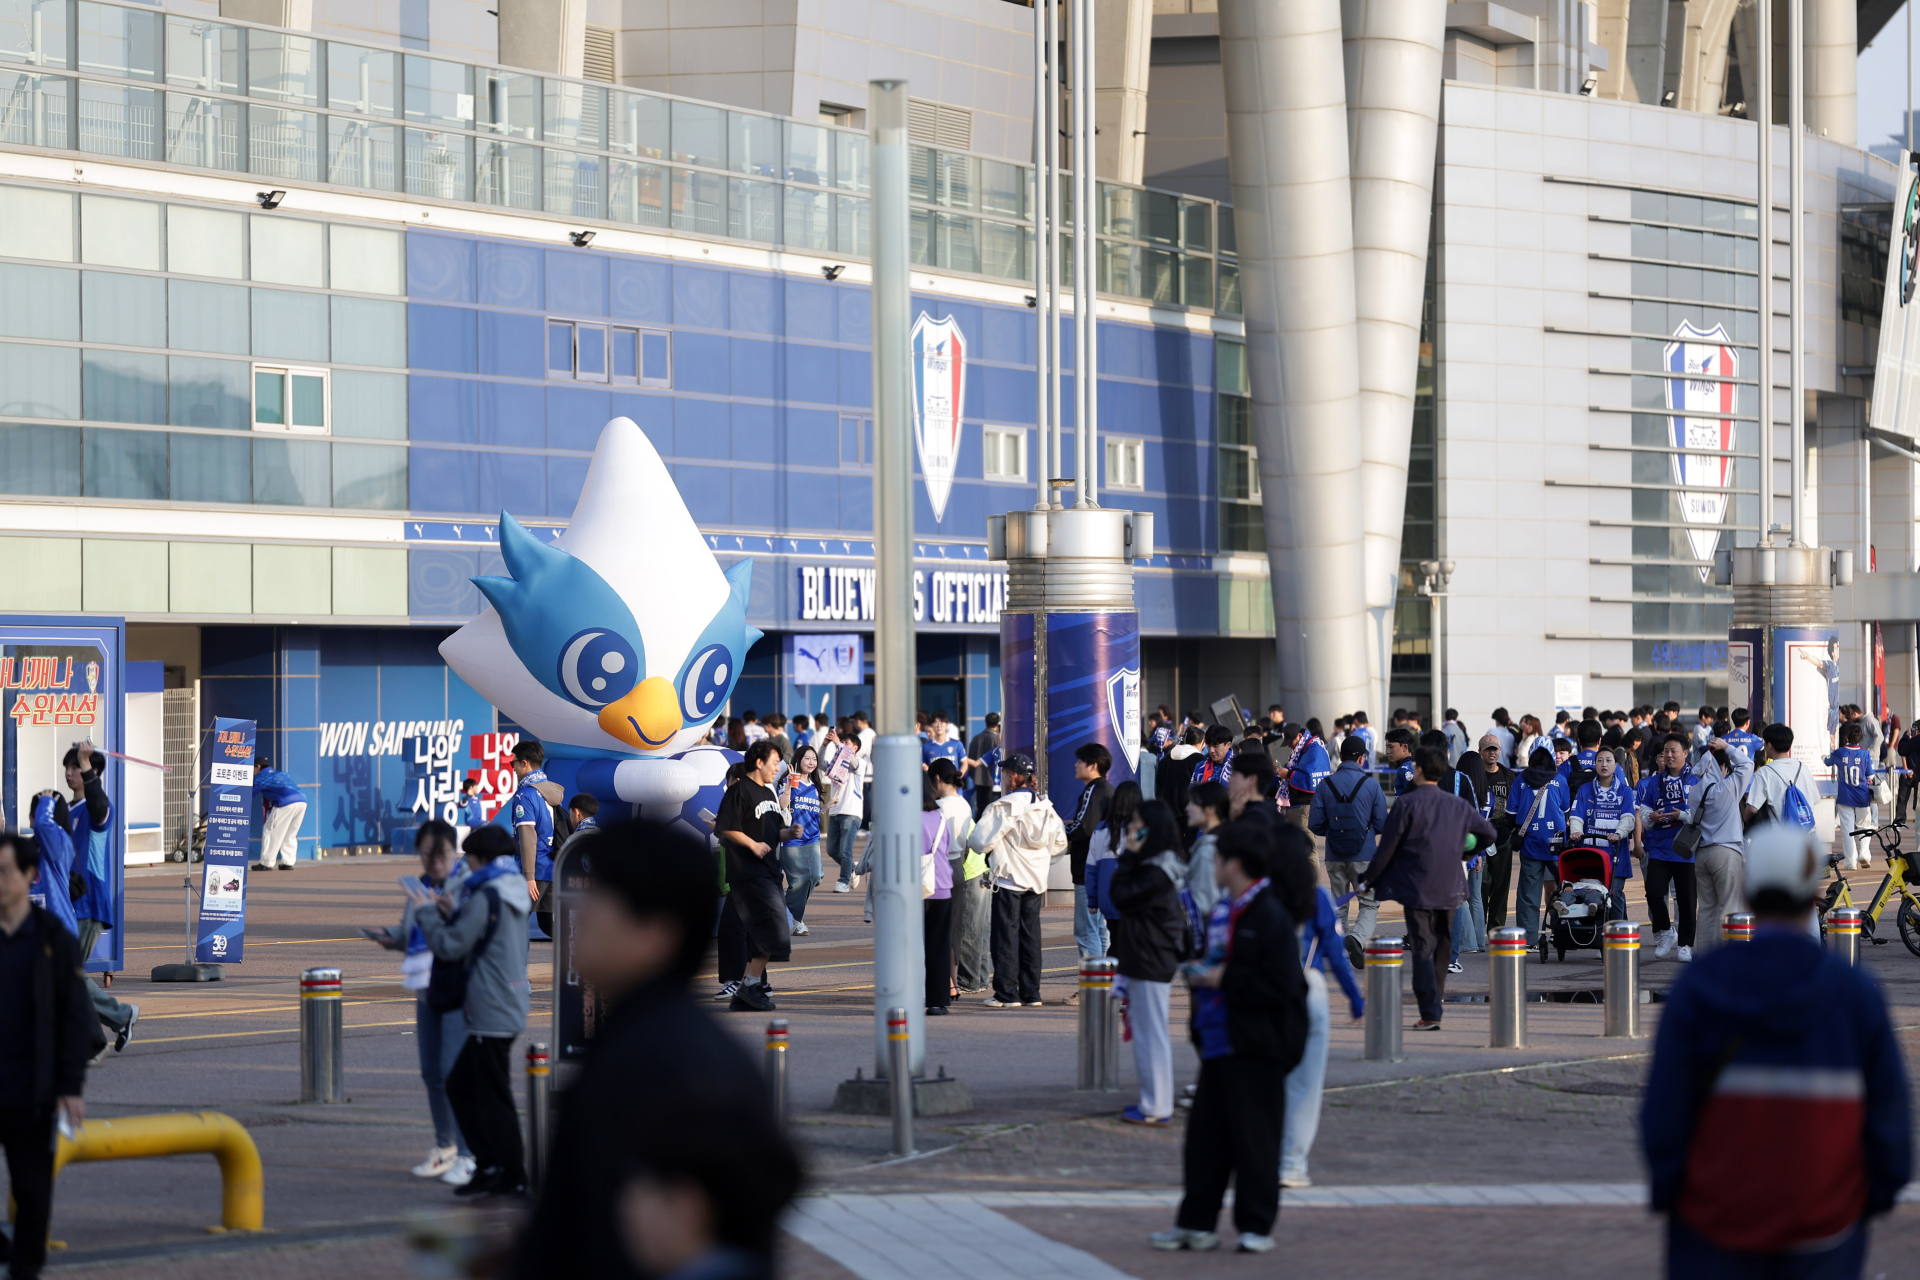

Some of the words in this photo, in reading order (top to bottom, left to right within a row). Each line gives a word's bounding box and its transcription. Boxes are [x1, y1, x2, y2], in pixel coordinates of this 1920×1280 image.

[1690, 500, 1717, 514] SUWON
[802, 566, 924, 621] BLUEWS
[10, 693, 98, 727] 수원삼성
[1844, 765, 1860, 787] 10
